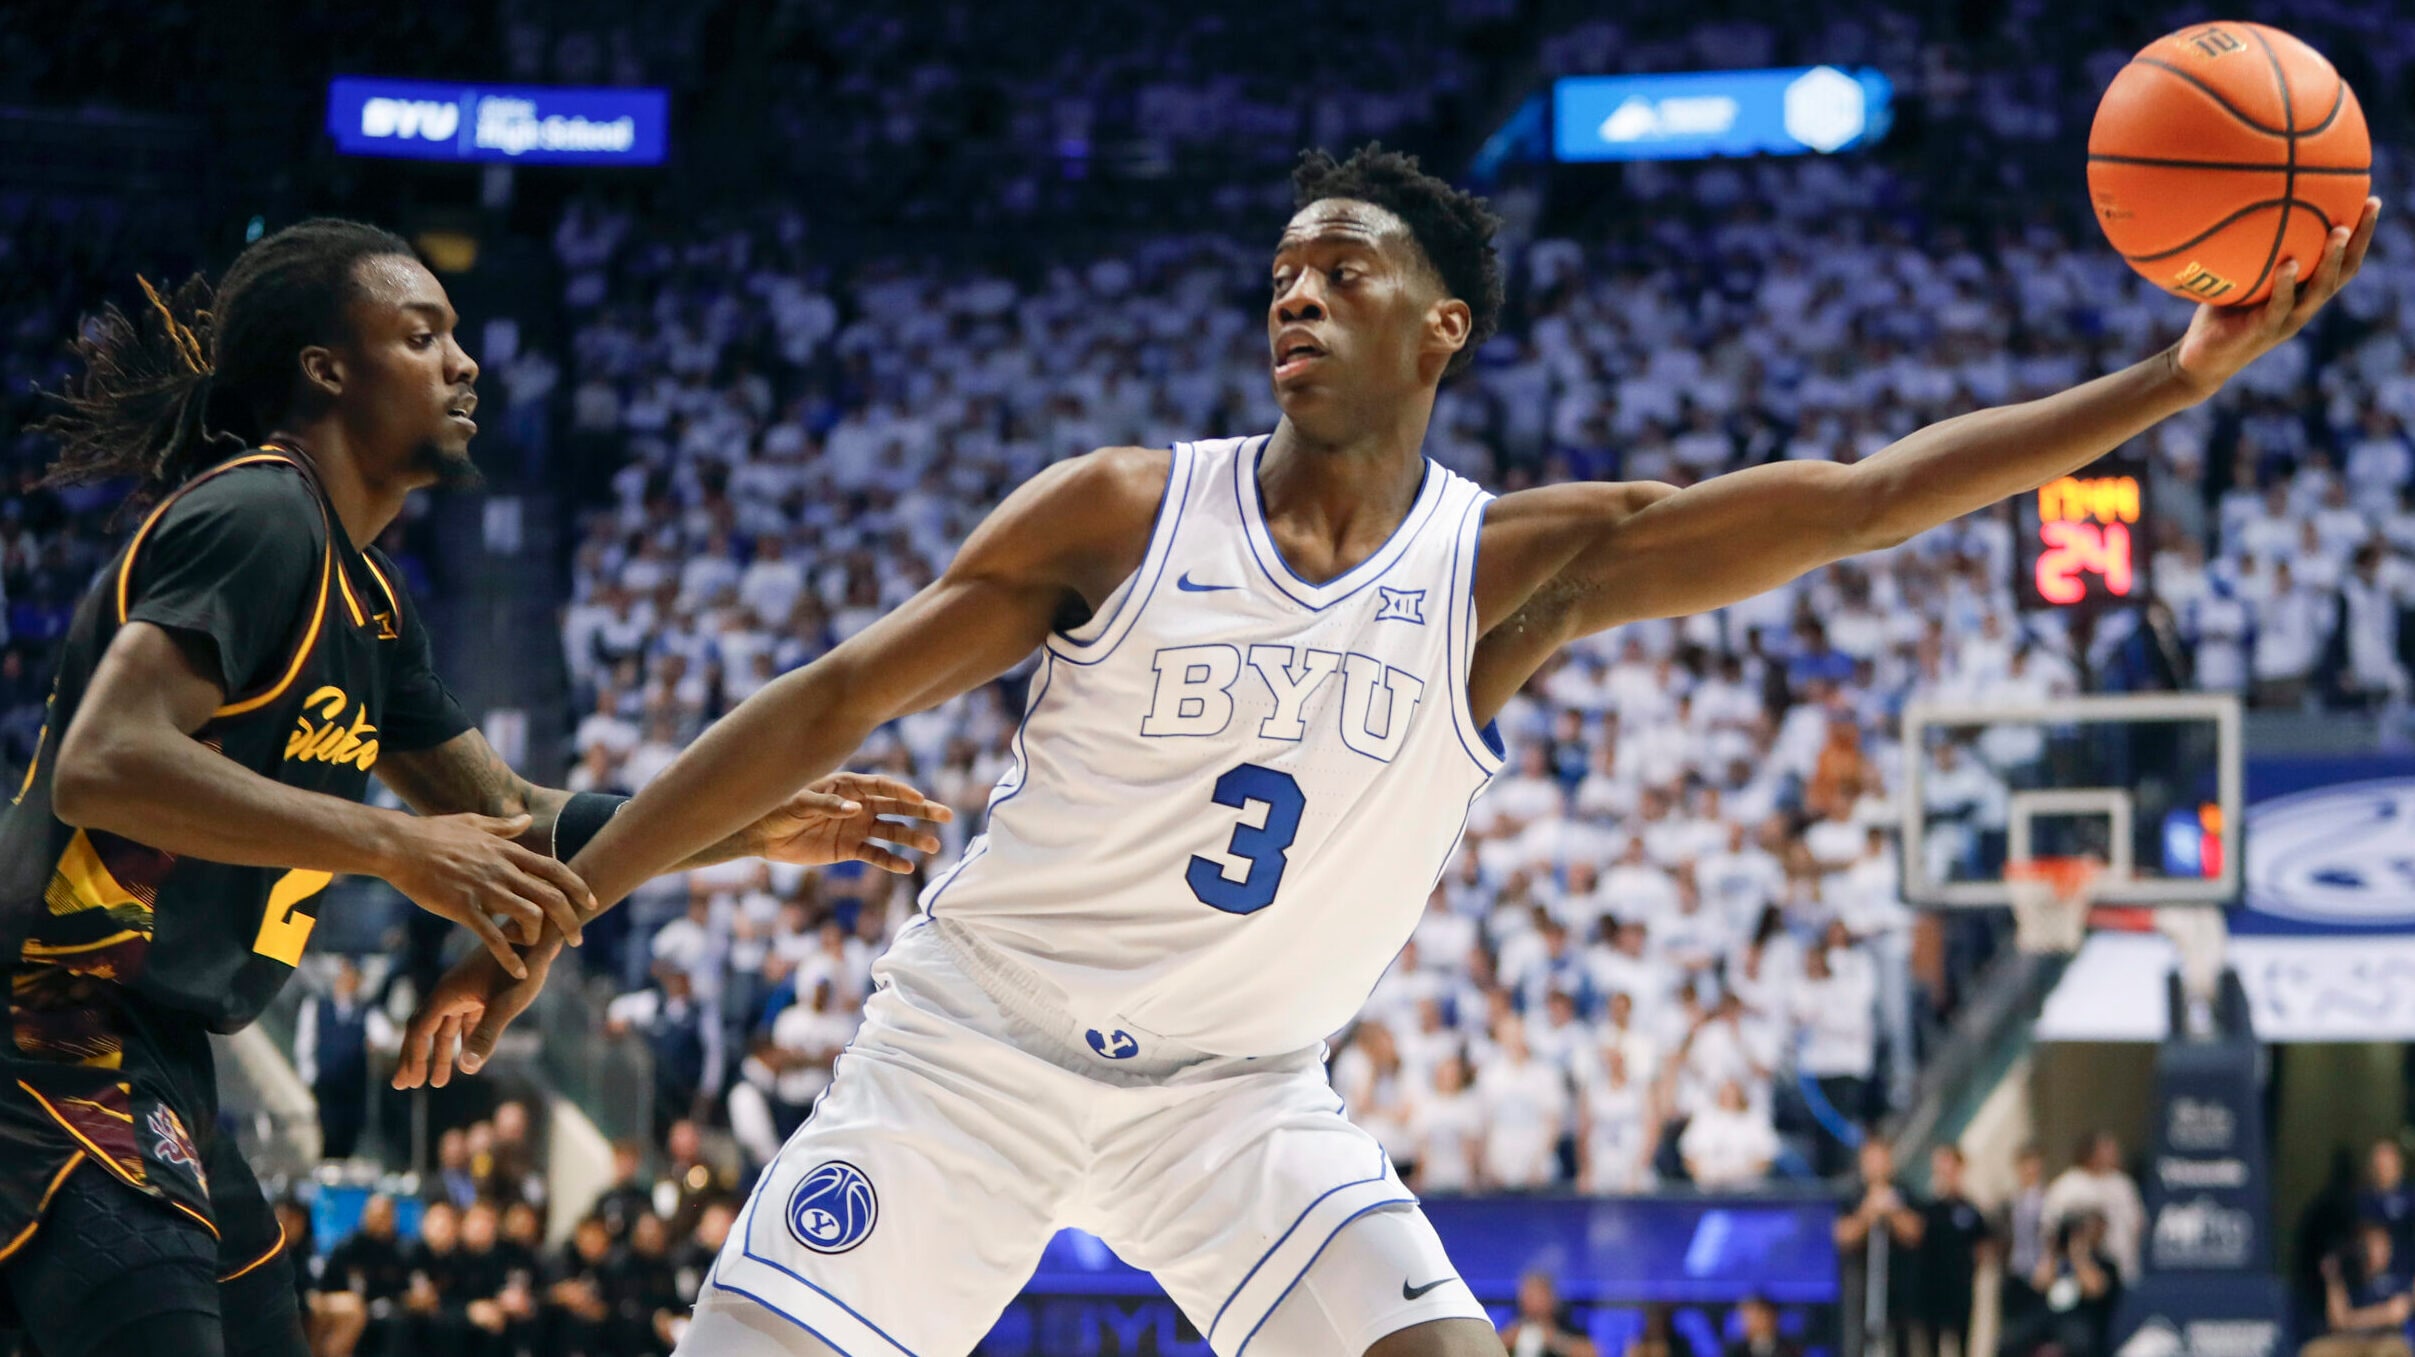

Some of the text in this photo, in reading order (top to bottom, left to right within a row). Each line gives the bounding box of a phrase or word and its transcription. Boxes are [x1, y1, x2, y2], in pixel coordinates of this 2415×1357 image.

[362, 97, 459, 141] BYU
[2036, 521, 2133, 604] 24
[1140, 643, 1425, 763] BYU
[1185, 762, 1307, 915] 3
[252, 868, 334, 968] 2
